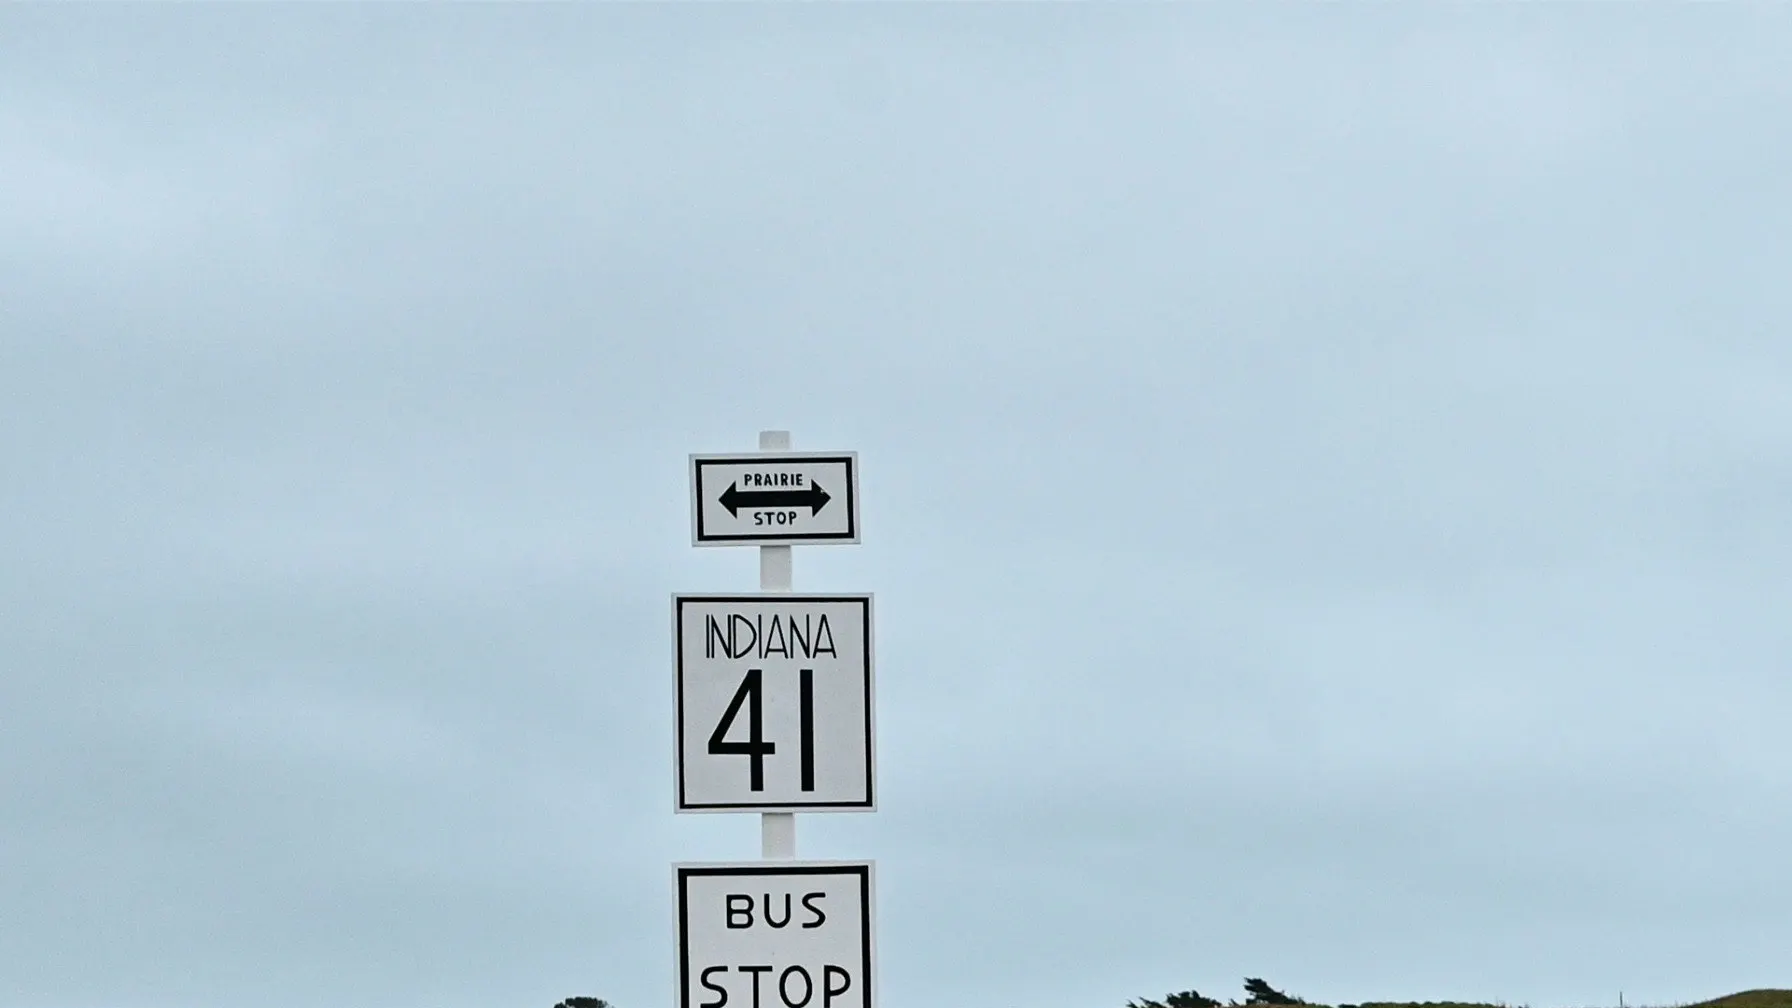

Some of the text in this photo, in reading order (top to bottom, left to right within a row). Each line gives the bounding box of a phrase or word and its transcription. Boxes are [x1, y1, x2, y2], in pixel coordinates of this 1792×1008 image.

[743, 472, 803, 487] PRAIRIE
[753, 511, 797, 526] STOP
[705, 613, 837, 660] INDIANA
[707, 668, 815, 792] 41
[725, 892, 827, 930] BUS
